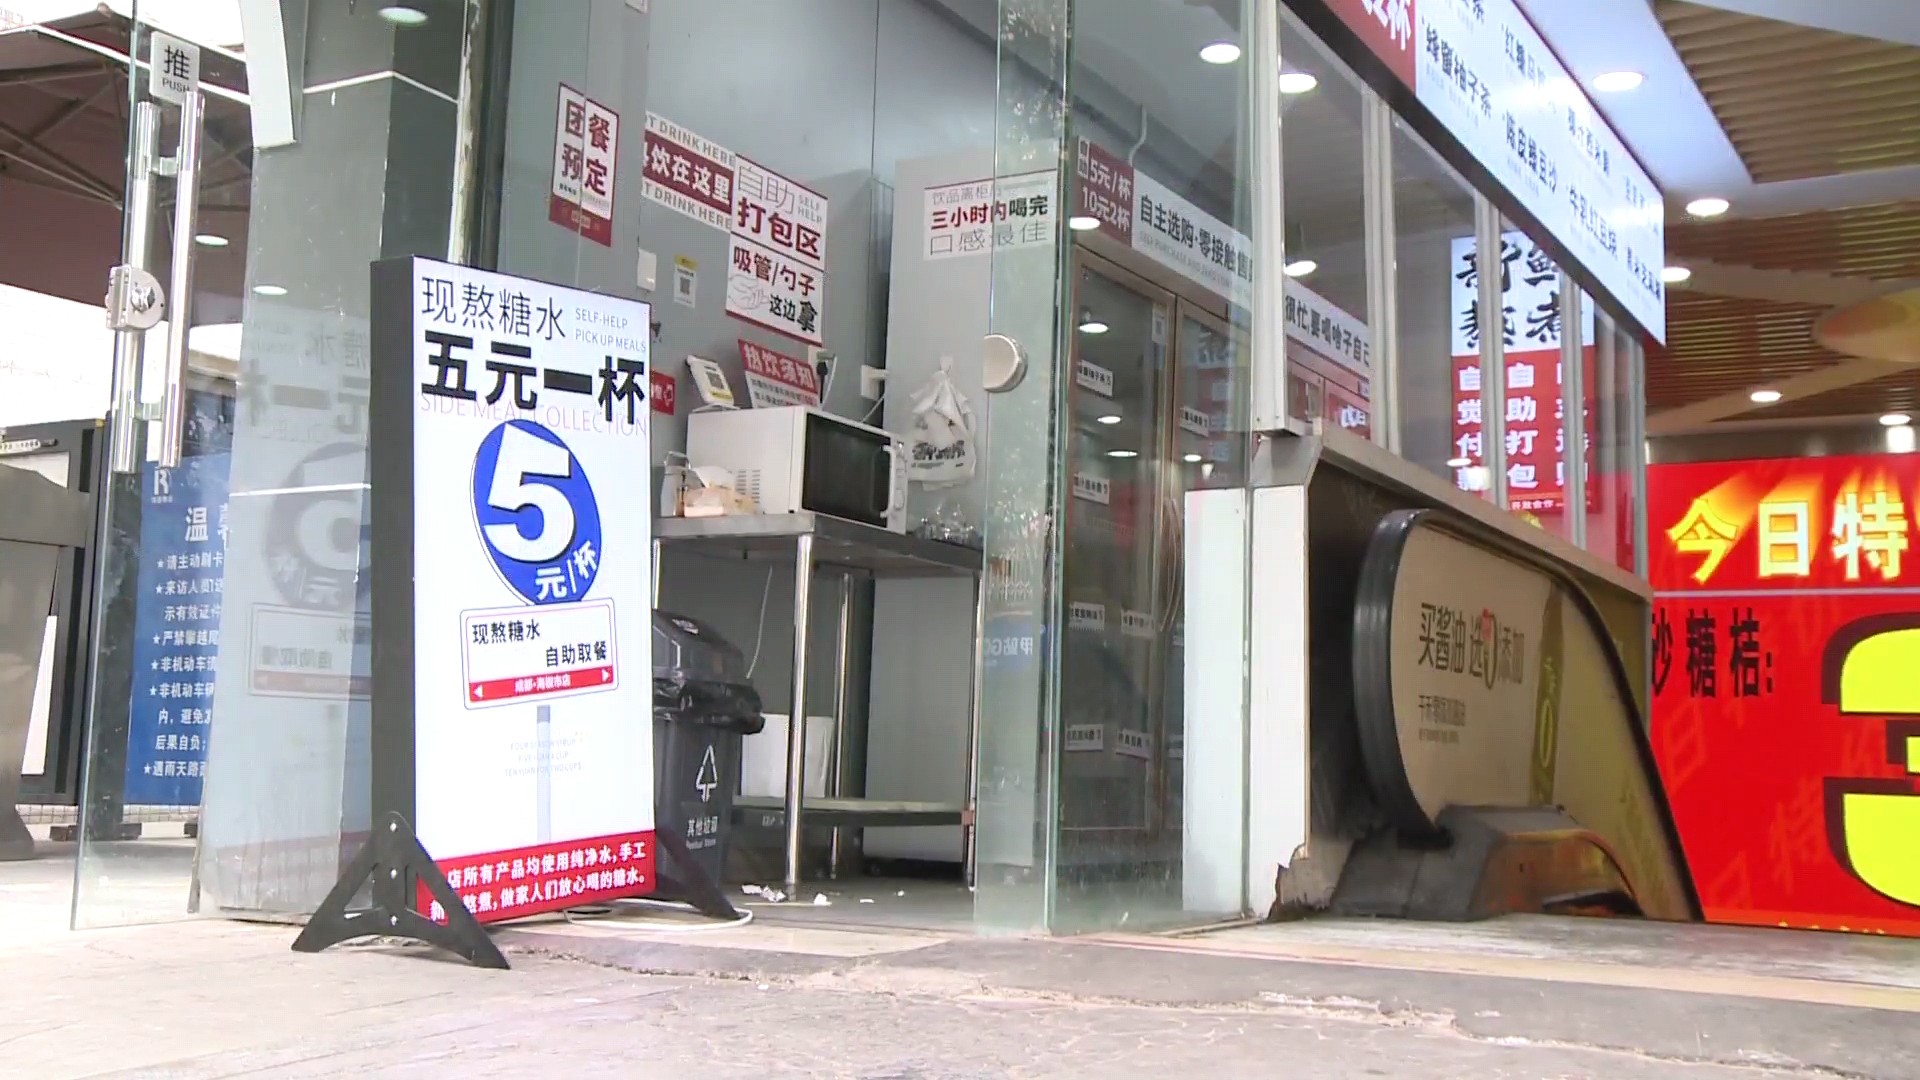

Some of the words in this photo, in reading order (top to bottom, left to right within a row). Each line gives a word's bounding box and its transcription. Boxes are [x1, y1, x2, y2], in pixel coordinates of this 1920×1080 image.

[163, 45, 190, 80] 推
[565, 98, 611, 154] 团餐
[659, 121, 700, 149] DRINK
[702, 141, 737, 167] HERE
[561, 142, 608, 197] 预定
[738, 164, 795, 215] 自助
[1089, 157, 1132, 202] 5元/杯
[654, 185, 696, 215] DRINK
[699, 206, 732, 231] HERE
[737, 196, 822, 261] 打包区
[930, 195, 1049, 230] 三小时内喝完
[929, 220, 1049, 256] 口感最佳
[733, 245, 816, 297] 吸管/勺子
[421, 276, 567, 341] 现熬糖水
[574, 307, 629, 330] SELF-HELP
[768, 294, 819, 334] 这边拿
[574, 329, 600, 347] PICK
[600, 333, 615, 348] UP
[615, 335, 647, 353] MEALS
[420, 329, 647, 426] 五元一杯
[1505, 362, 1539, 490] 自助打包
[481, 421, 578, 564] 5
[1665, 490, 1910, 584] 今日特
[535, 540, 597, 601] 元/杯
[471, 618, 541, 646] 现熬糖水
[545, 639, 608, 668] 自助取餐
